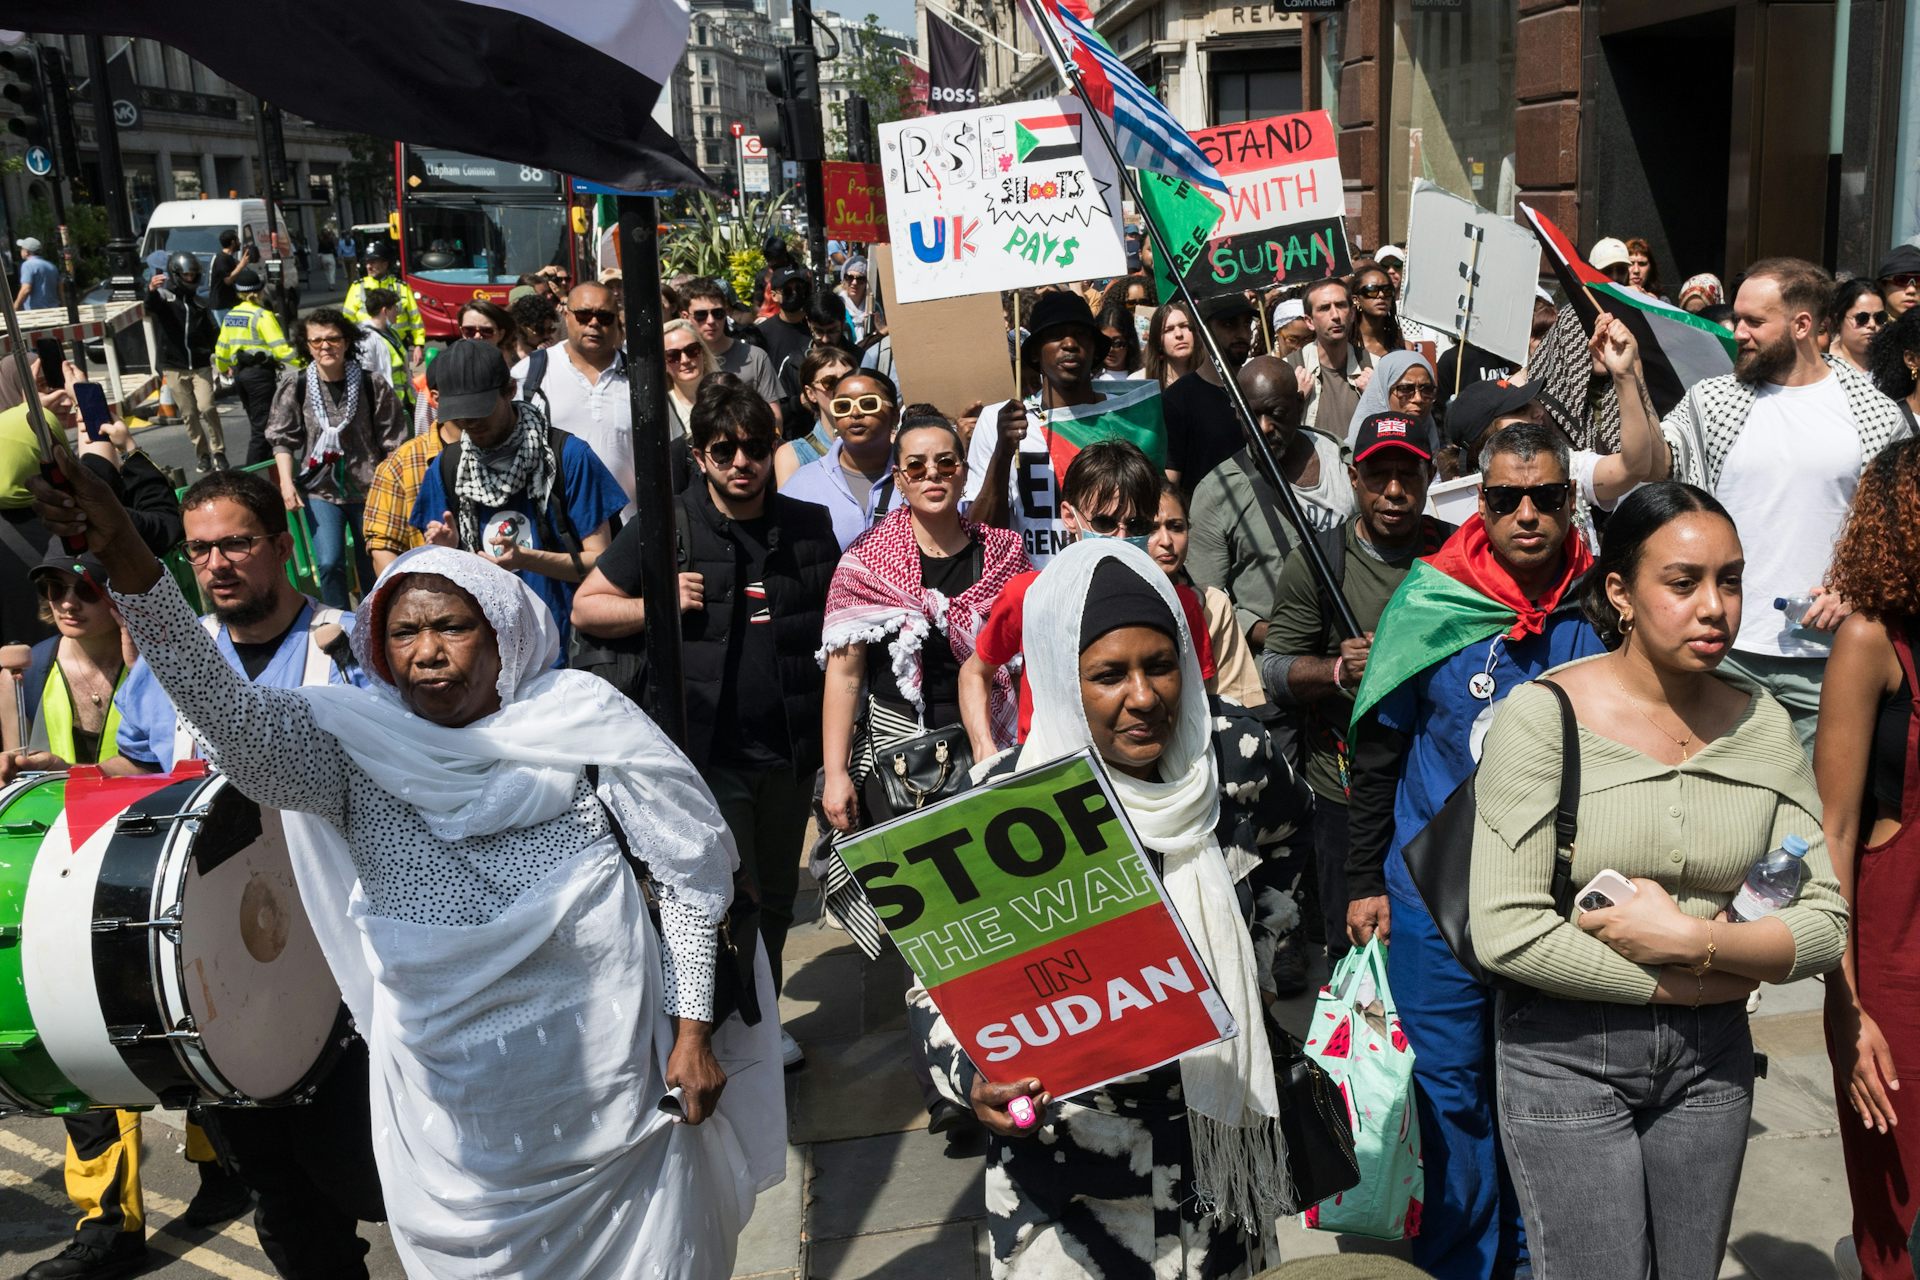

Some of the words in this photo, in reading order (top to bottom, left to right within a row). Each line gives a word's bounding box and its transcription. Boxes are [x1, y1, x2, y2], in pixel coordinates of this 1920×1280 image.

[1232, 4, 1302, 24] REI
[931, 86, 976, 103] BOSS
[899, 114, 1006, 194] RSF
[1196, 118, 1312, 167] STAND
[425, 163, 460, 179] Clapham
[462, 163, 496, 177] Common
[520, 164, 543, 182] 88
[1001, 170, 1086, 204] SHOOTS
[1228, 168, 1318, 222] WITH
[834, 198, 888, 225] Suda
[909, 214, 983, 264] UK
[1211, 228, 1335, 284] SUDAN
[225, 318, 248, 327] POLICE
[852, 779, 1120, 932] STOP
[897, 907, 1016, 978] THE
[1024, 948, 1092, 998] IN
[975, 956, 1195, 1062] SUDAN
